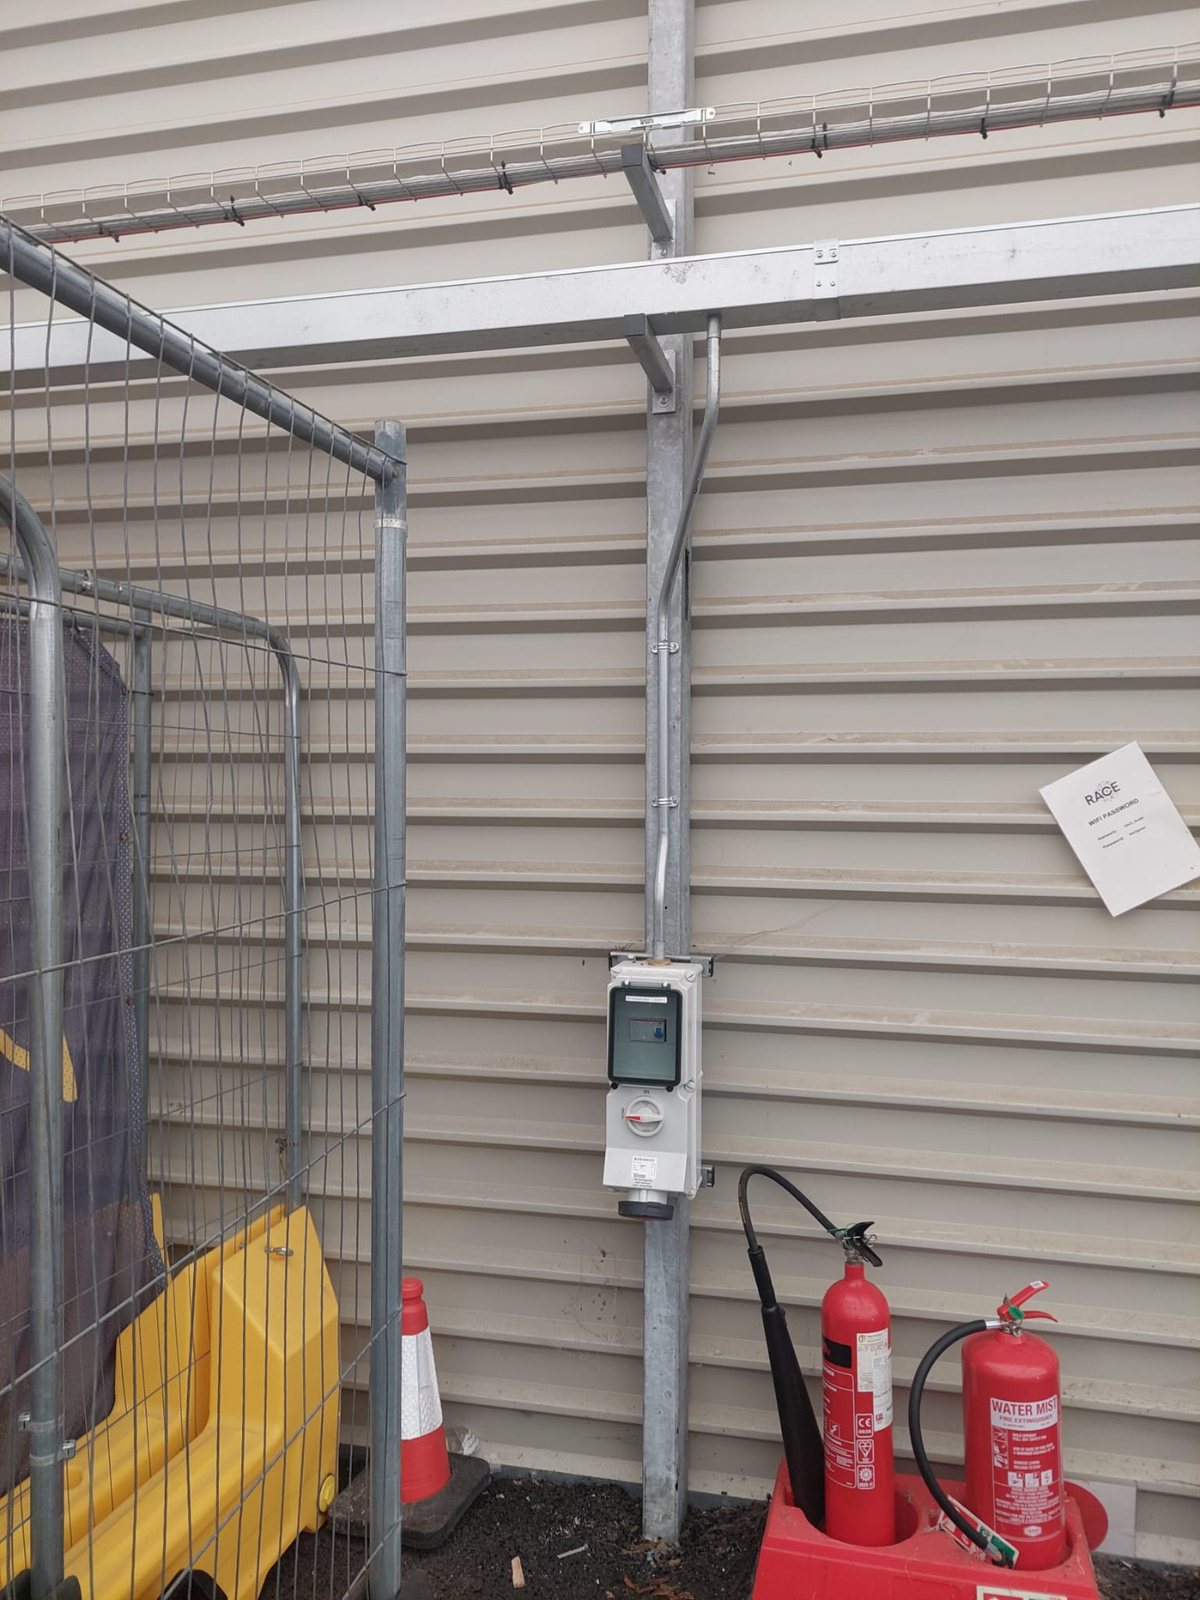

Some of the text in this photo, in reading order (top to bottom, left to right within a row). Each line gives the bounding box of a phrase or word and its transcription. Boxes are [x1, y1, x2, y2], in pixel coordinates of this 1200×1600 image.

[1084, 781, 1121, 806] RACE
[1088, 798, 1140, 826] WIFI PASSWORD
[992, 1398, 1057, 1416] WATER MIST
[858, 1418, 871, 1427] CE
[999, 1415, 1013, 1423] FIRE
